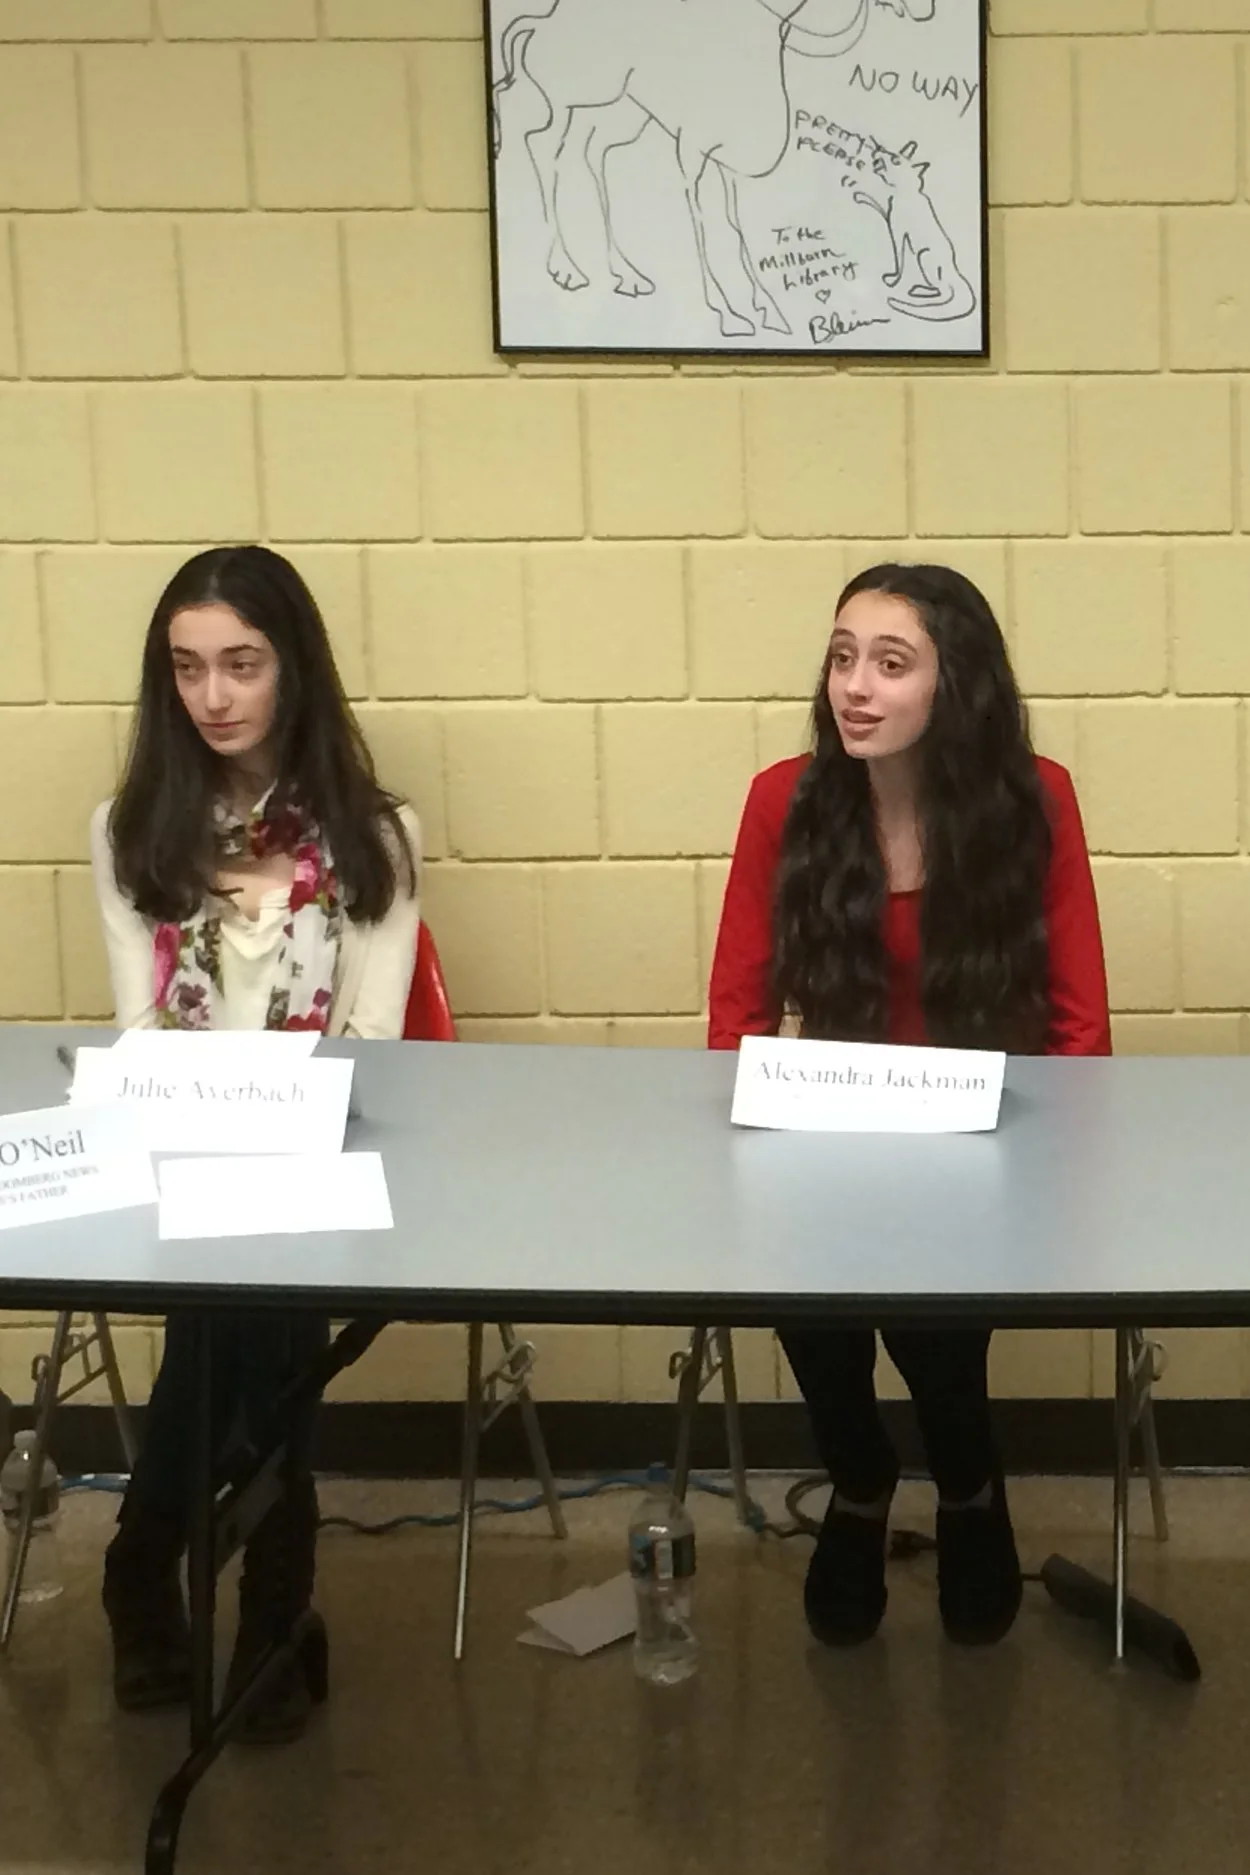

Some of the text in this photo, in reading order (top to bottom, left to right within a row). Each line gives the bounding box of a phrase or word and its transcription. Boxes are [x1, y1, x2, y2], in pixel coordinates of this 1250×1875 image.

[849, 64, 979, 118] NO WAY
[797, 227, 826, 240] the
[117, 1076, 177, 1099] Julie
[754, 1061, 986, 1091] Alexandra Jackman
